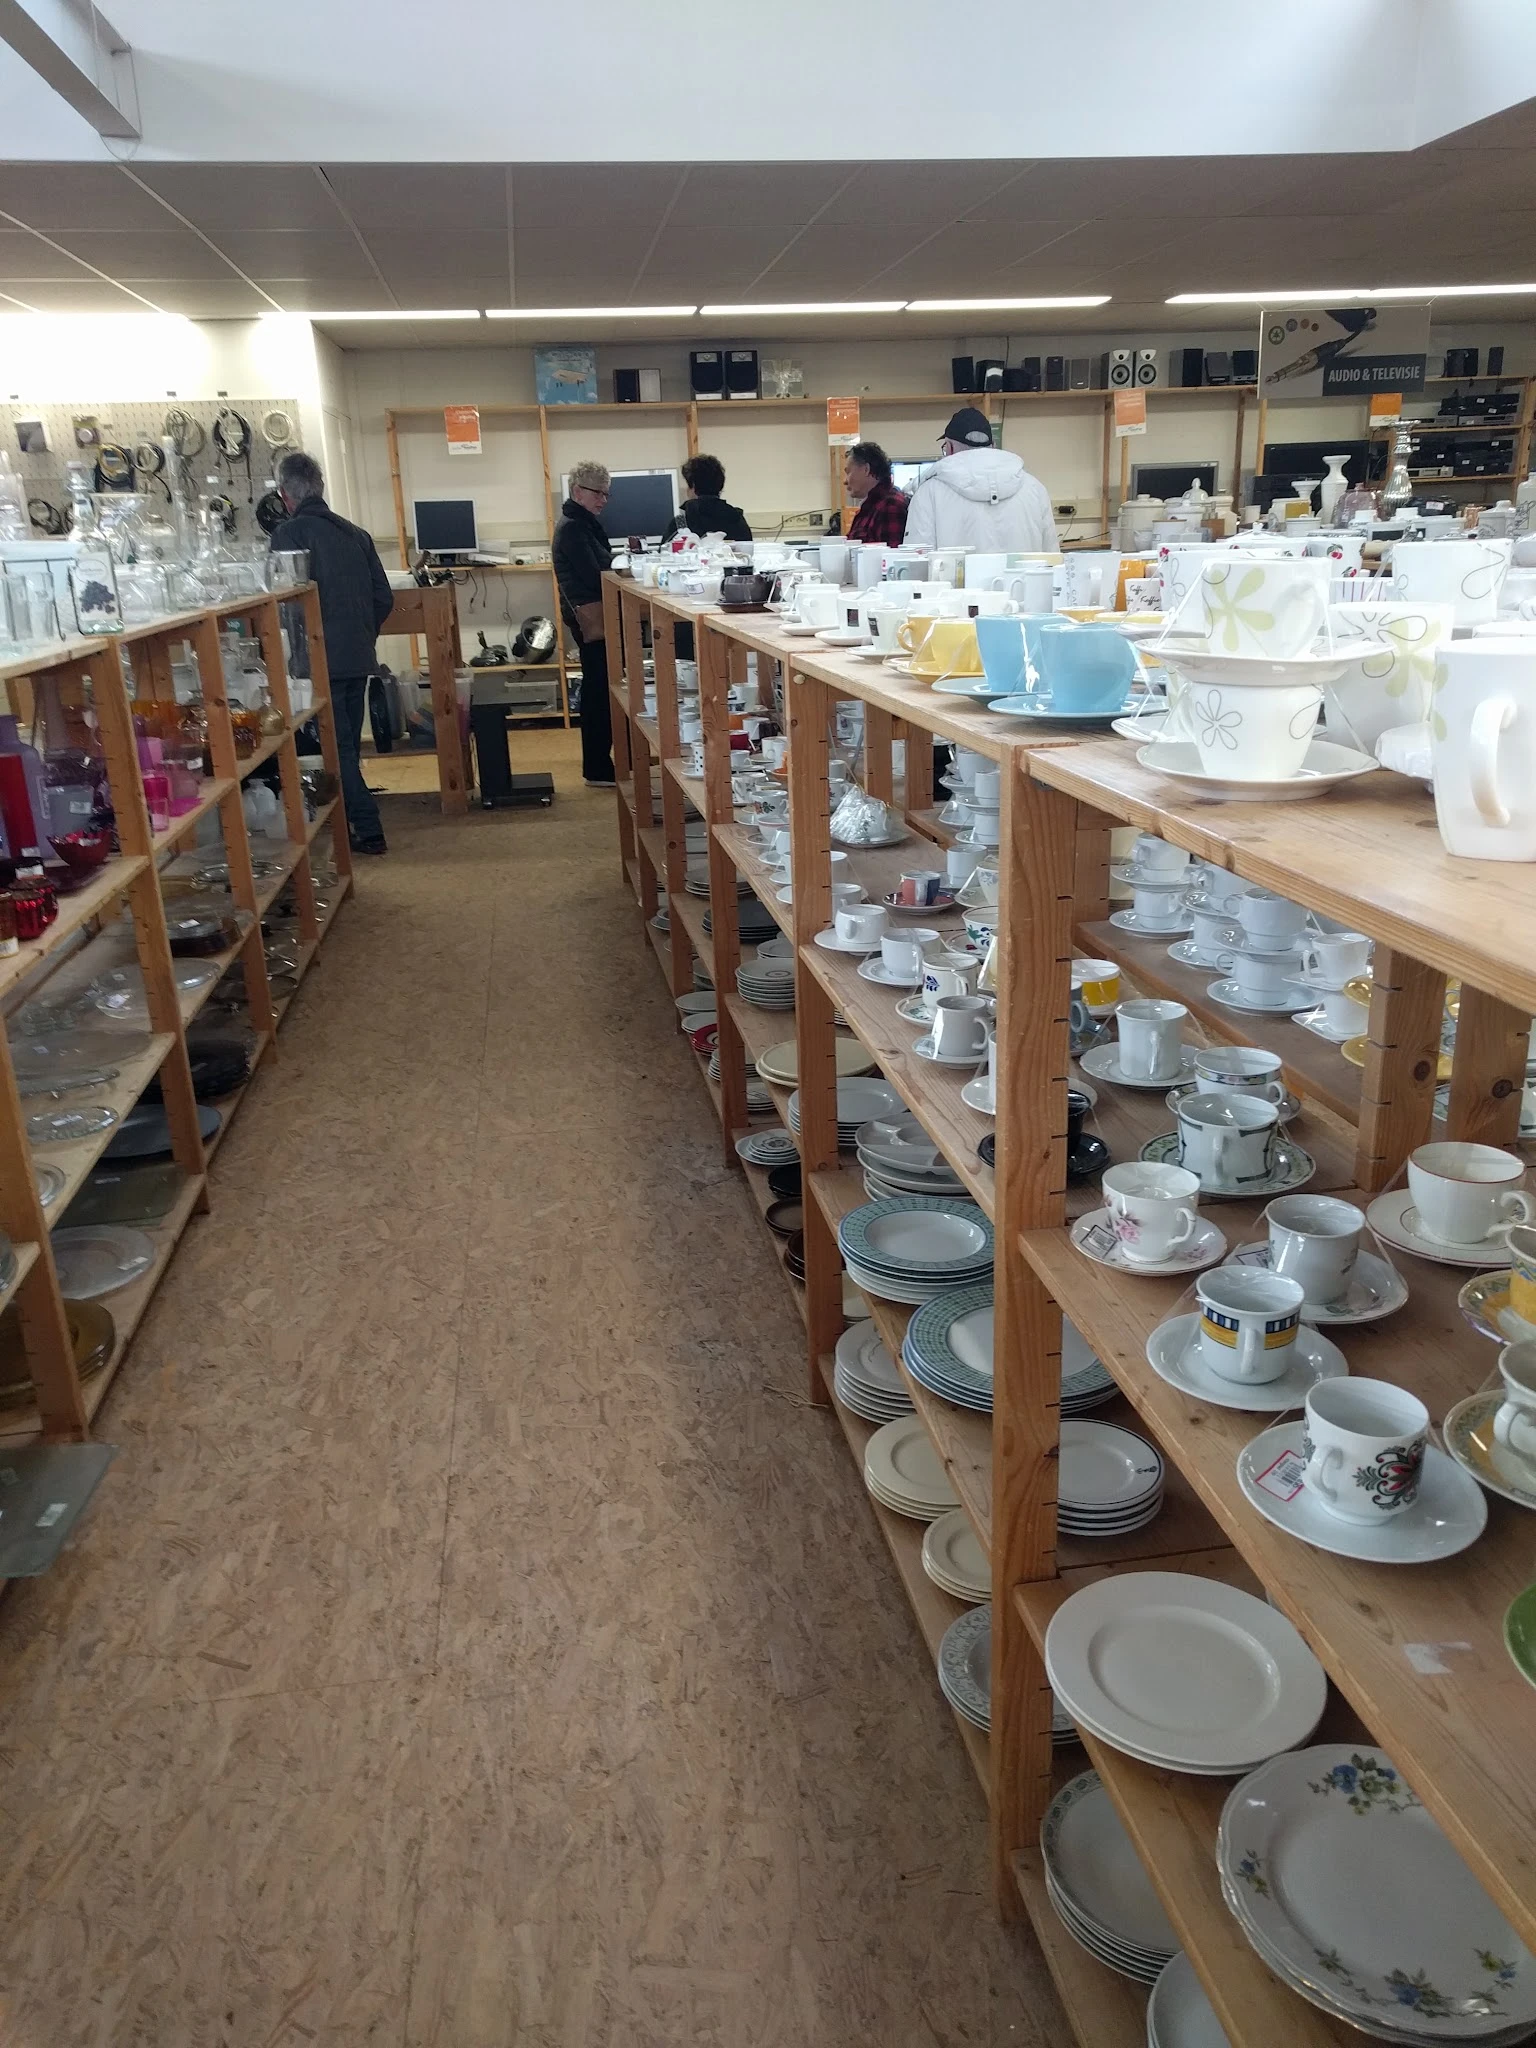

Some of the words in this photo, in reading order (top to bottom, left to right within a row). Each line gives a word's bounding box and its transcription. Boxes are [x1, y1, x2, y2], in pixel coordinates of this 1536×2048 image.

[1328, 368, 1360, 382] AUDIO
[1362, 368, 1370, 381] &
[1372, 365, 1420, 380] TELEVISIE
